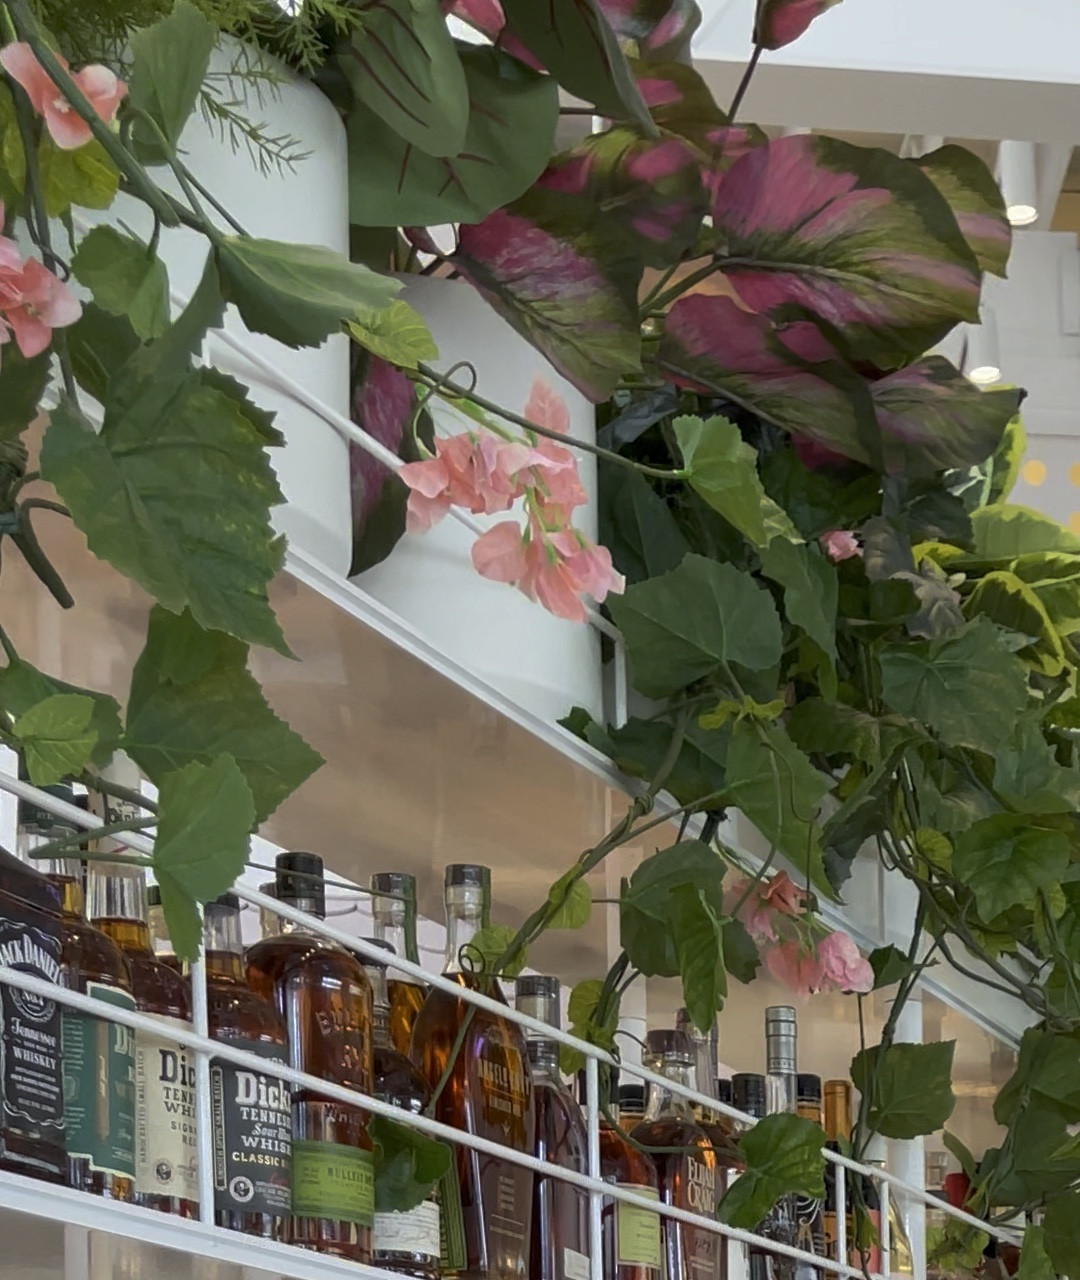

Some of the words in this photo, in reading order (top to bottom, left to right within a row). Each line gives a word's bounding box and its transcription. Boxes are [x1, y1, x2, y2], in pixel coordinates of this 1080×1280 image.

[12, 1045, 57, 1070] WHISKEY
[159, 1048, 196, 1086] Dic
[164, 1086, 196, 1105] TENN
[235, 1070, 291, 1113] Dick
[164, 1101, 196, 1118] WHI
[171, 1121, 197, 1135] SIGN
[232, 1151, 279, 1167] CLASSIC
[688, 1156, 715, 1189] ELIJAH
[688, 1182, 715, 1213] CRAIG
